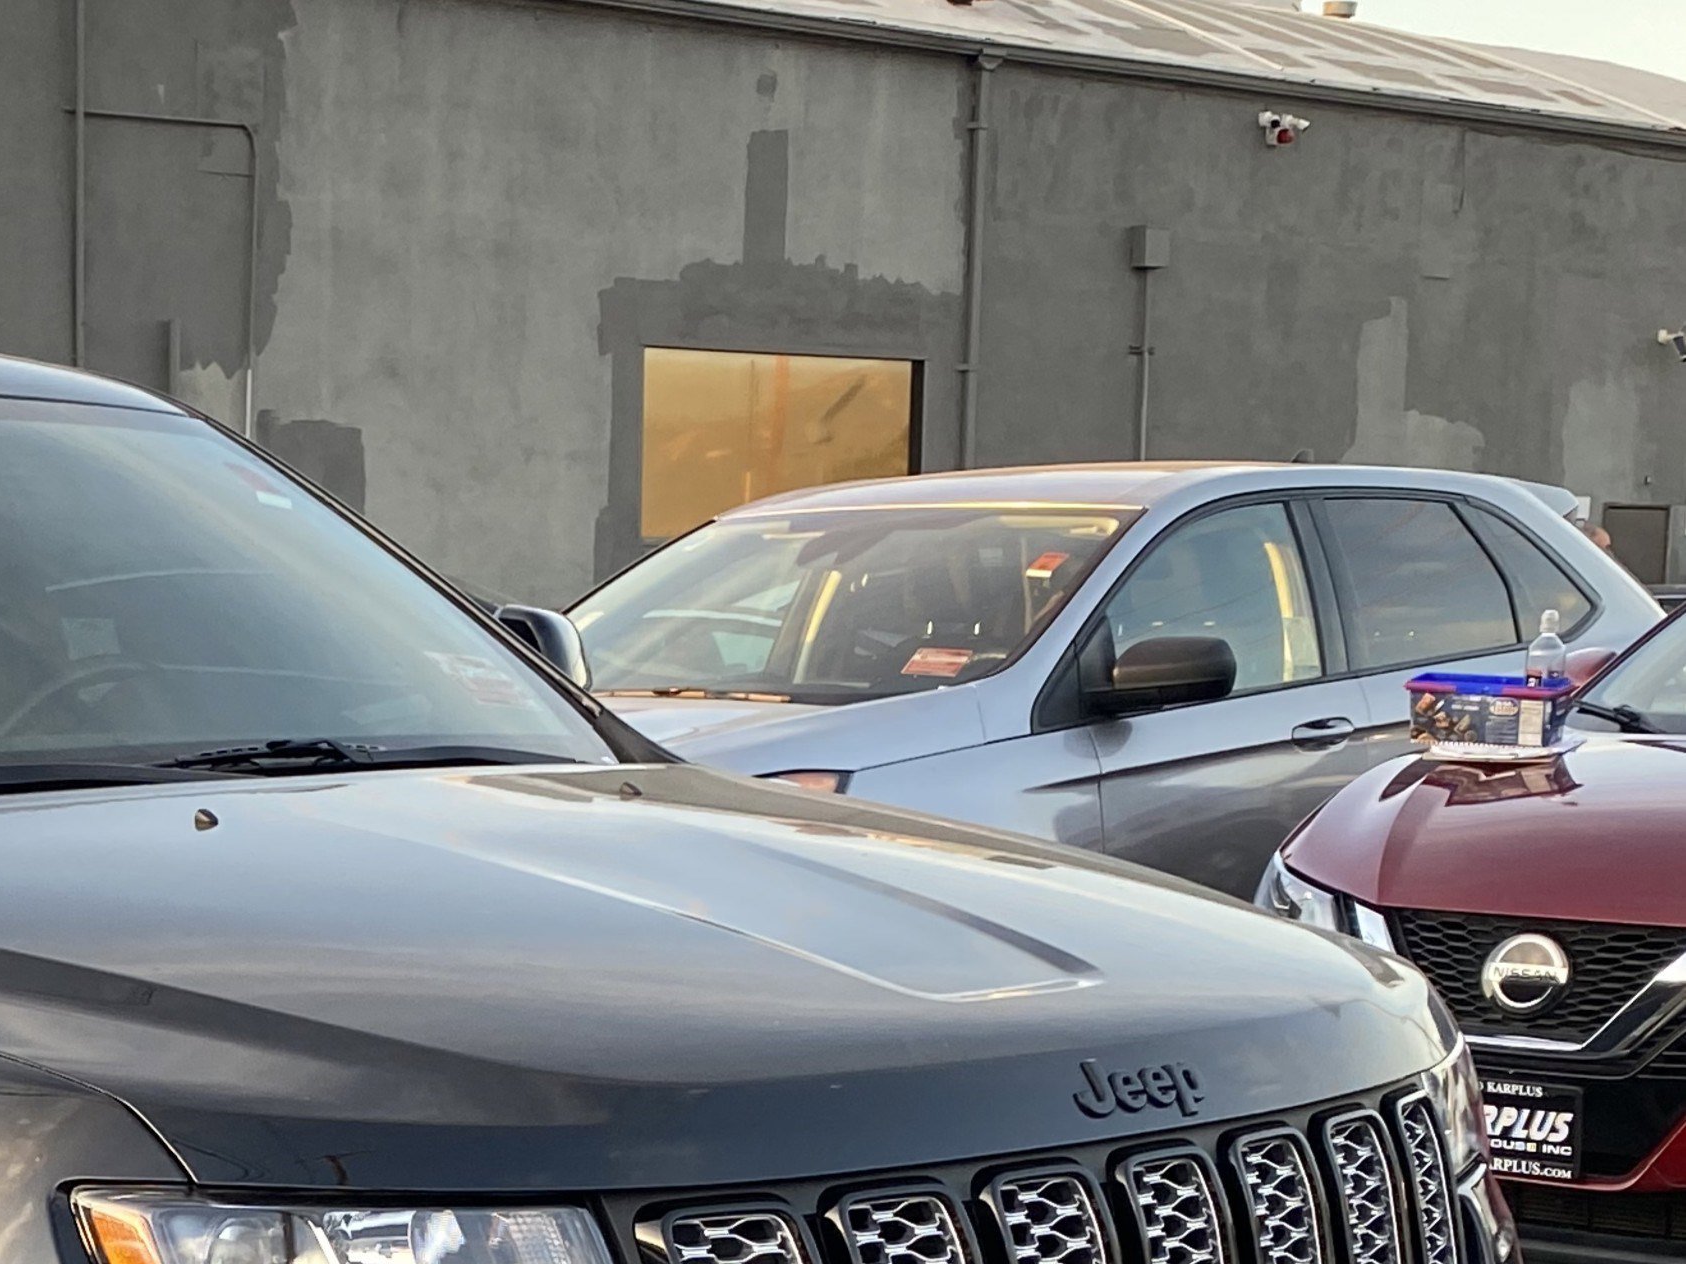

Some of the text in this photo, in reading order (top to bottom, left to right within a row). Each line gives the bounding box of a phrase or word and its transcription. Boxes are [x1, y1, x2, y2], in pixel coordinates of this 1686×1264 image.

[1492, 966, 1558, 982] NISSAN
[1072, 1058, 1206, 1119] Jeep
[1486, 1081, 1543, 1097] KARPLUS
[1541, 1143, 1572, 1156] INC
